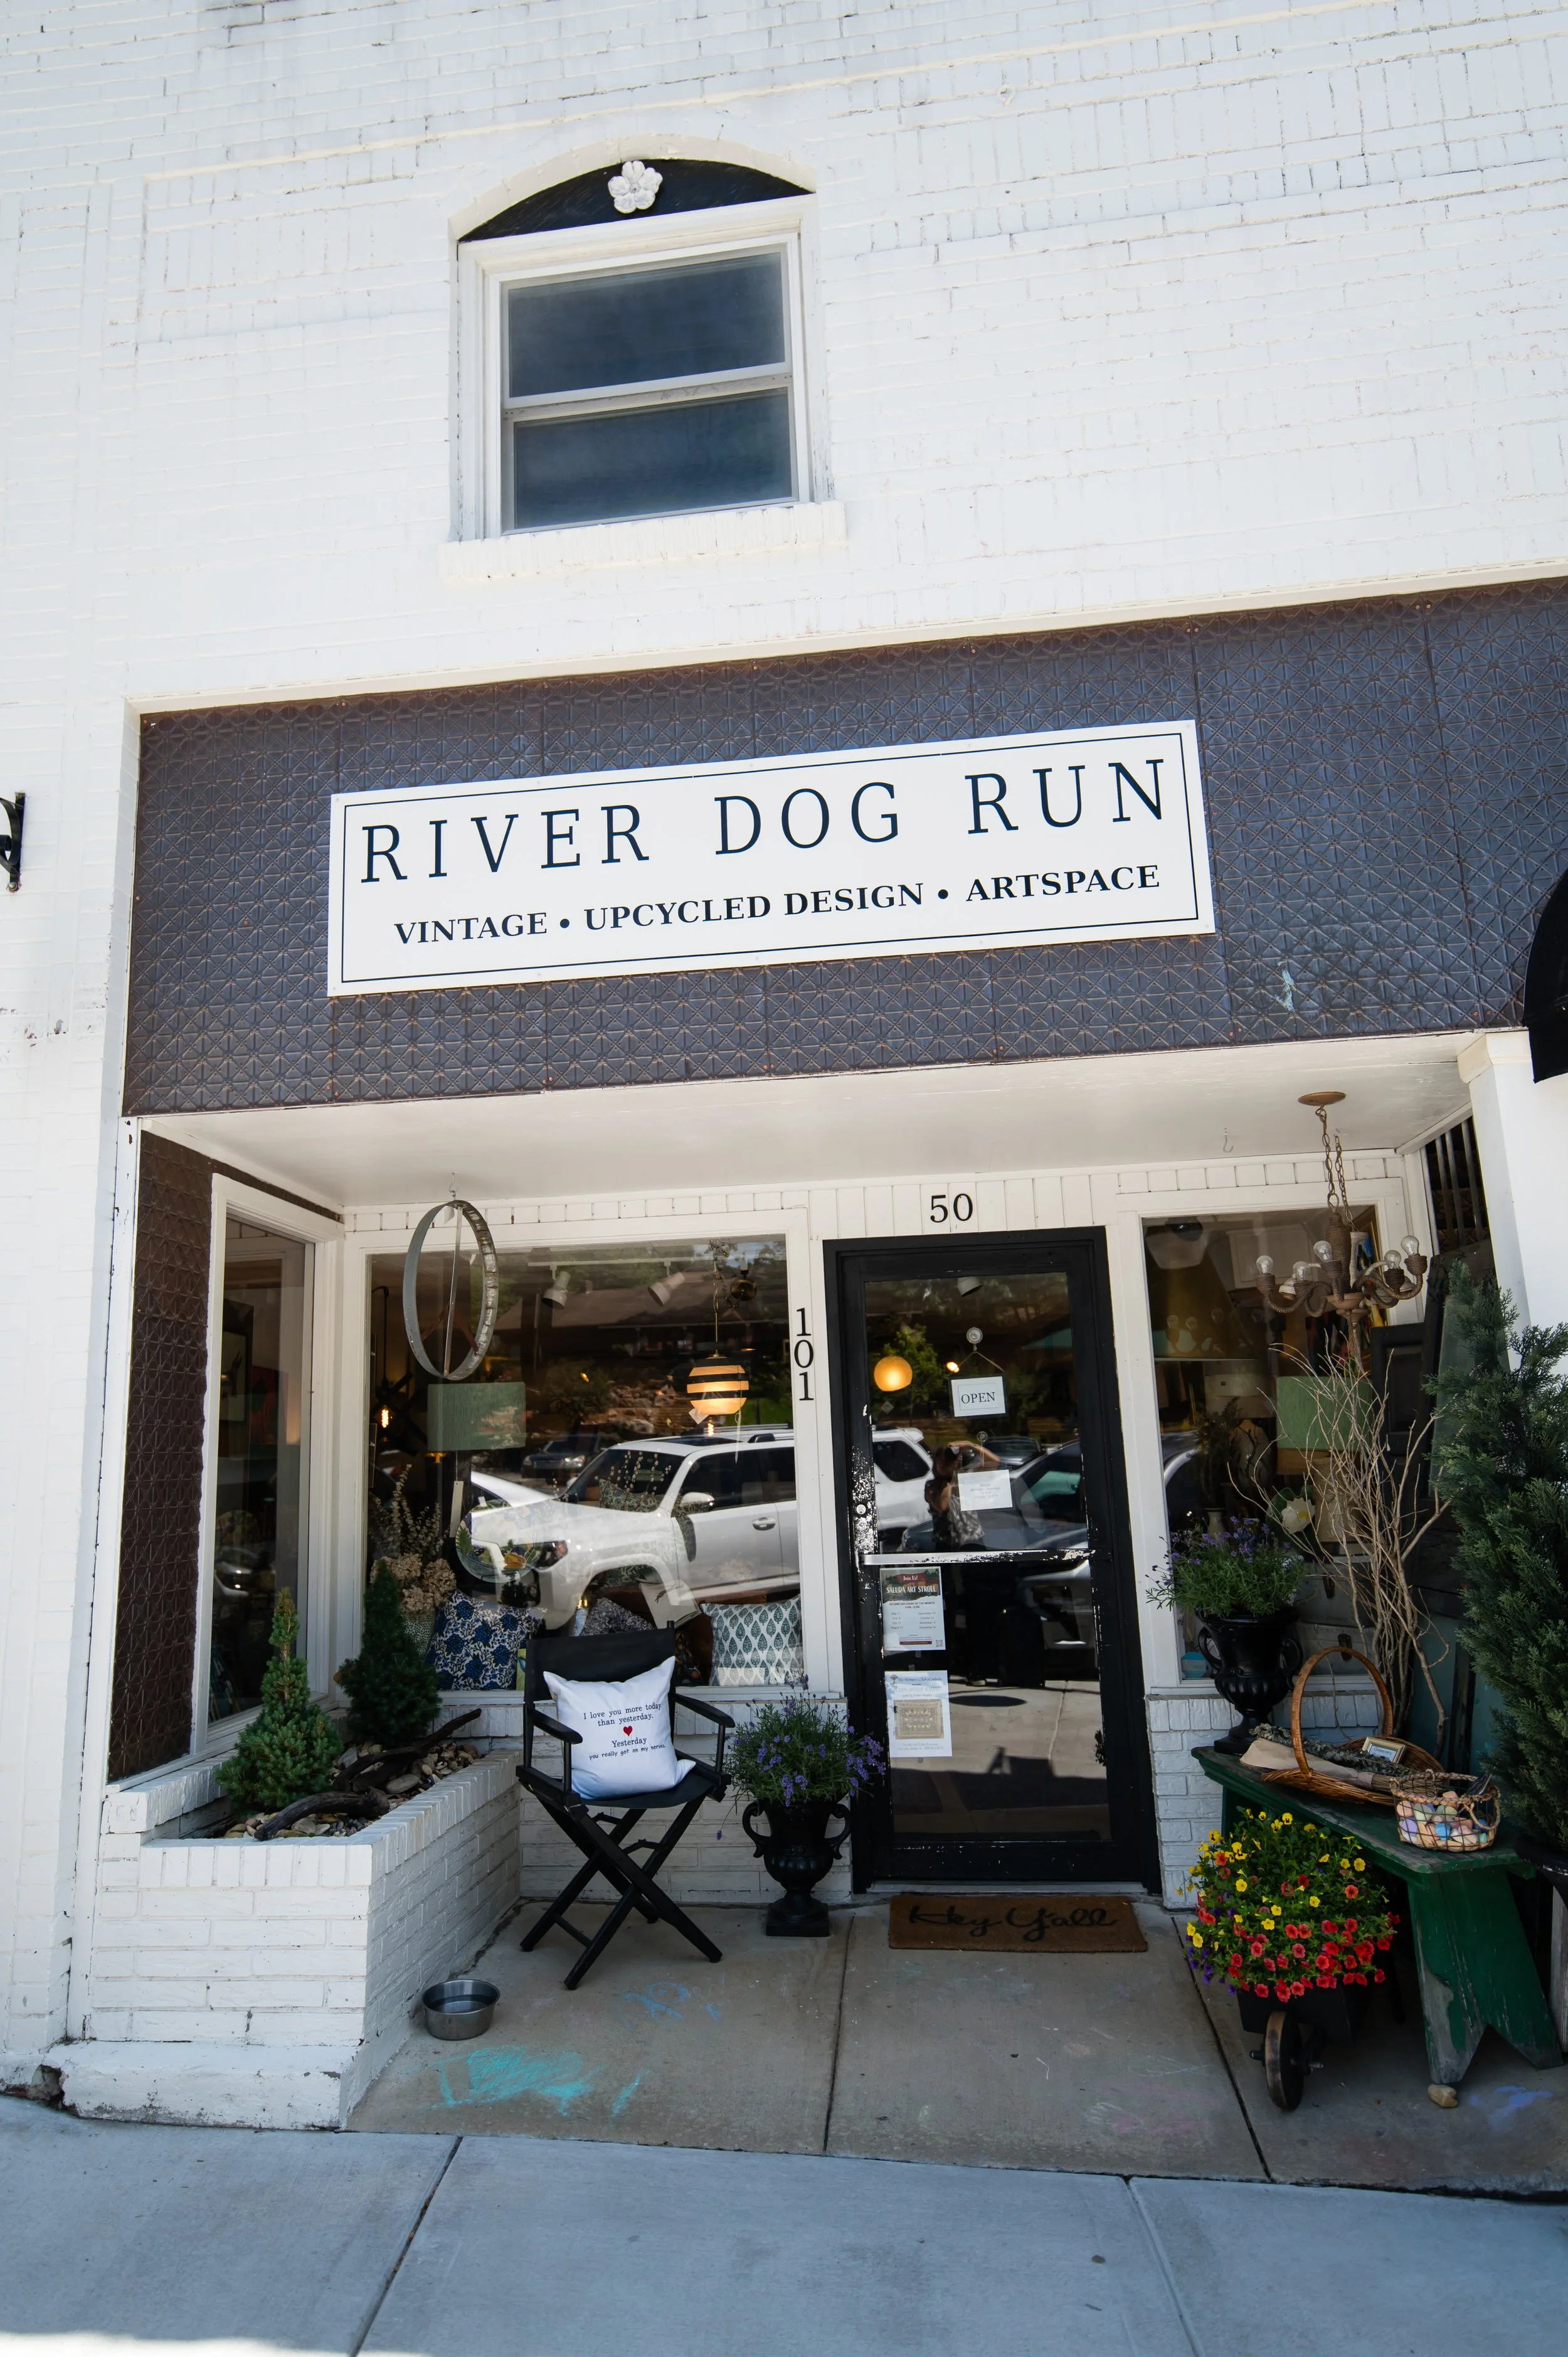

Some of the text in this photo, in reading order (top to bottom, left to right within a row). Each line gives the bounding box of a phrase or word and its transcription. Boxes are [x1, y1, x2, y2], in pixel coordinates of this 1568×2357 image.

[361, 759, 1164, 883] RIVER DOG RUN
[394, 865, 1160, 944] VINTAGE UPCYCLED DESIGN ARTSPACE
[930, 1193, 973, 1223] 50
[793, 1307, 815, 1402] 101
[961, 1391, 995, 1404] OPEN
[645, 1702, 662, 1710] today
[618, 1713, 654, 1725] yesterday.
[612, 1737, 647, 1748] Yesterday
